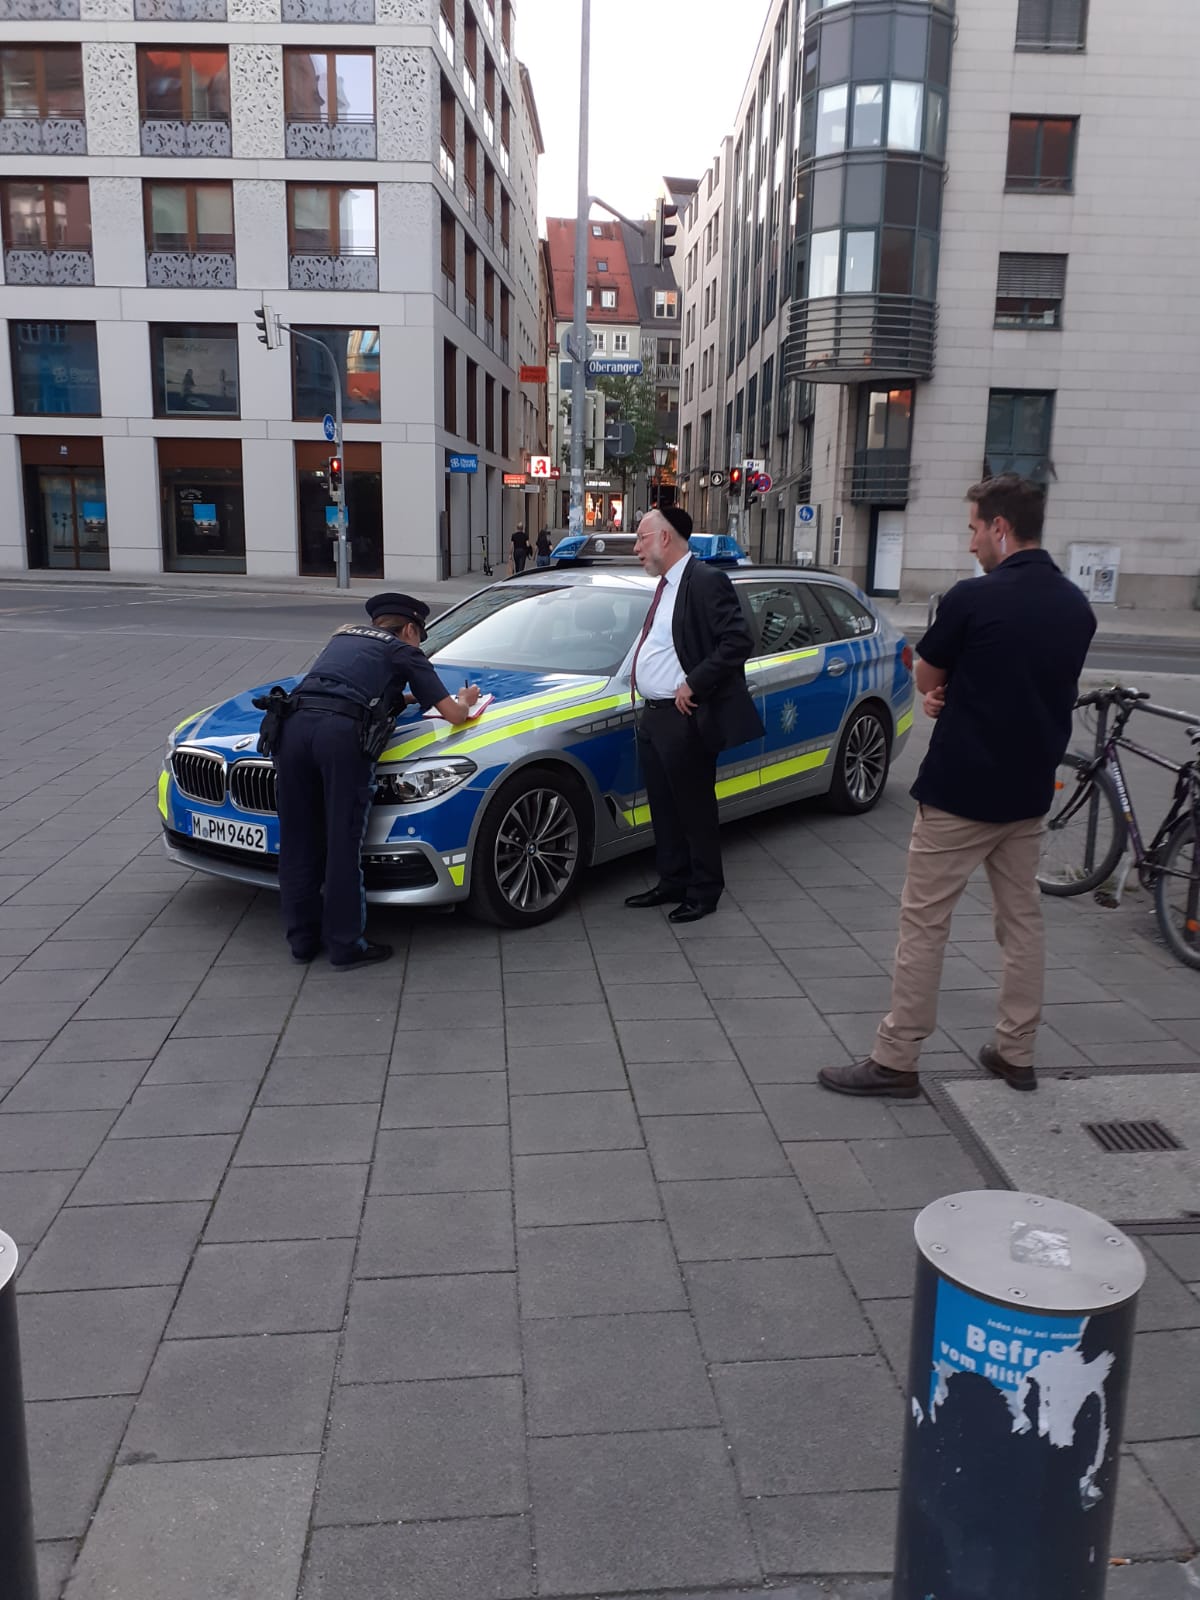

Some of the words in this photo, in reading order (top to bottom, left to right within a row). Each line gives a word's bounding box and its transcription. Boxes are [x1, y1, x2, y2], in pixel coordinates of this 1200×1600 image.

[589, 361, 640, 375] Oberanger
[193, 815, 201, 837] M
[208, 819, 226, 842] PM
[228, 824, 264, 849] 9462
[940, 1341, 977, 1371] vom
[983, 1361, 1026, 1386] Hitl
